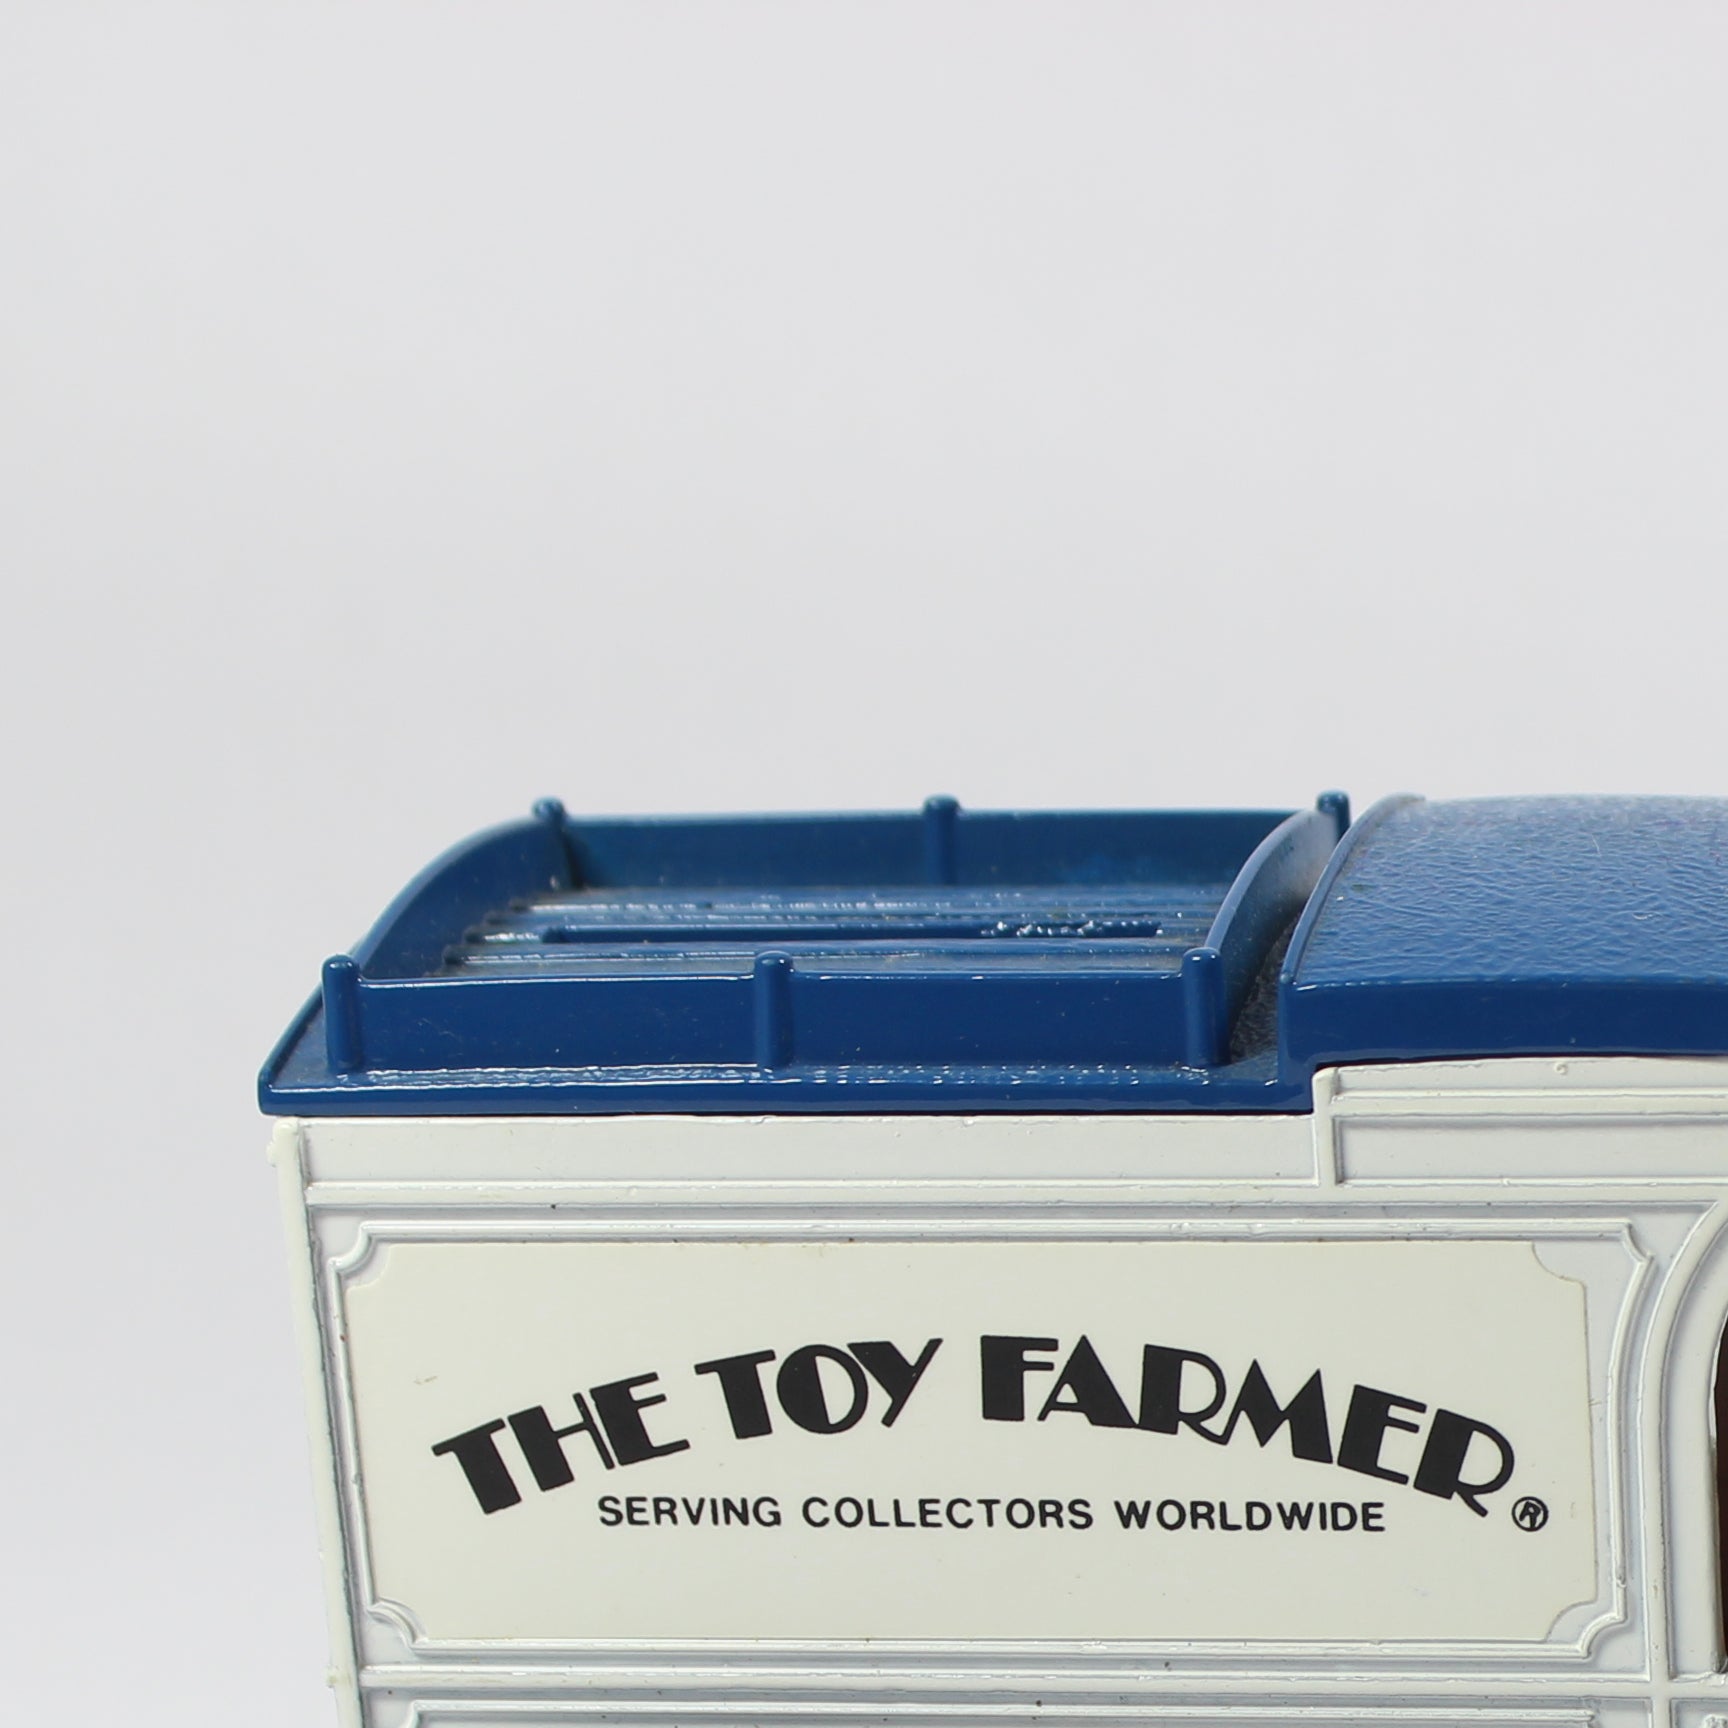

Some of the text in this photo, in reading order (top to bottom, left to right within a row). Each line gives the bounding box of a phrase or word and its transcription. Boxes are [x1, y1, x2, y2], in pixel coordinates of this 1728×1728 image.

[432, 1371, 690, 1515] THE
[694, 1337, 943, 1440] TOY
[598, 1495, 1386, 1532] SERVING COLLECTORS WORLDWIDE
